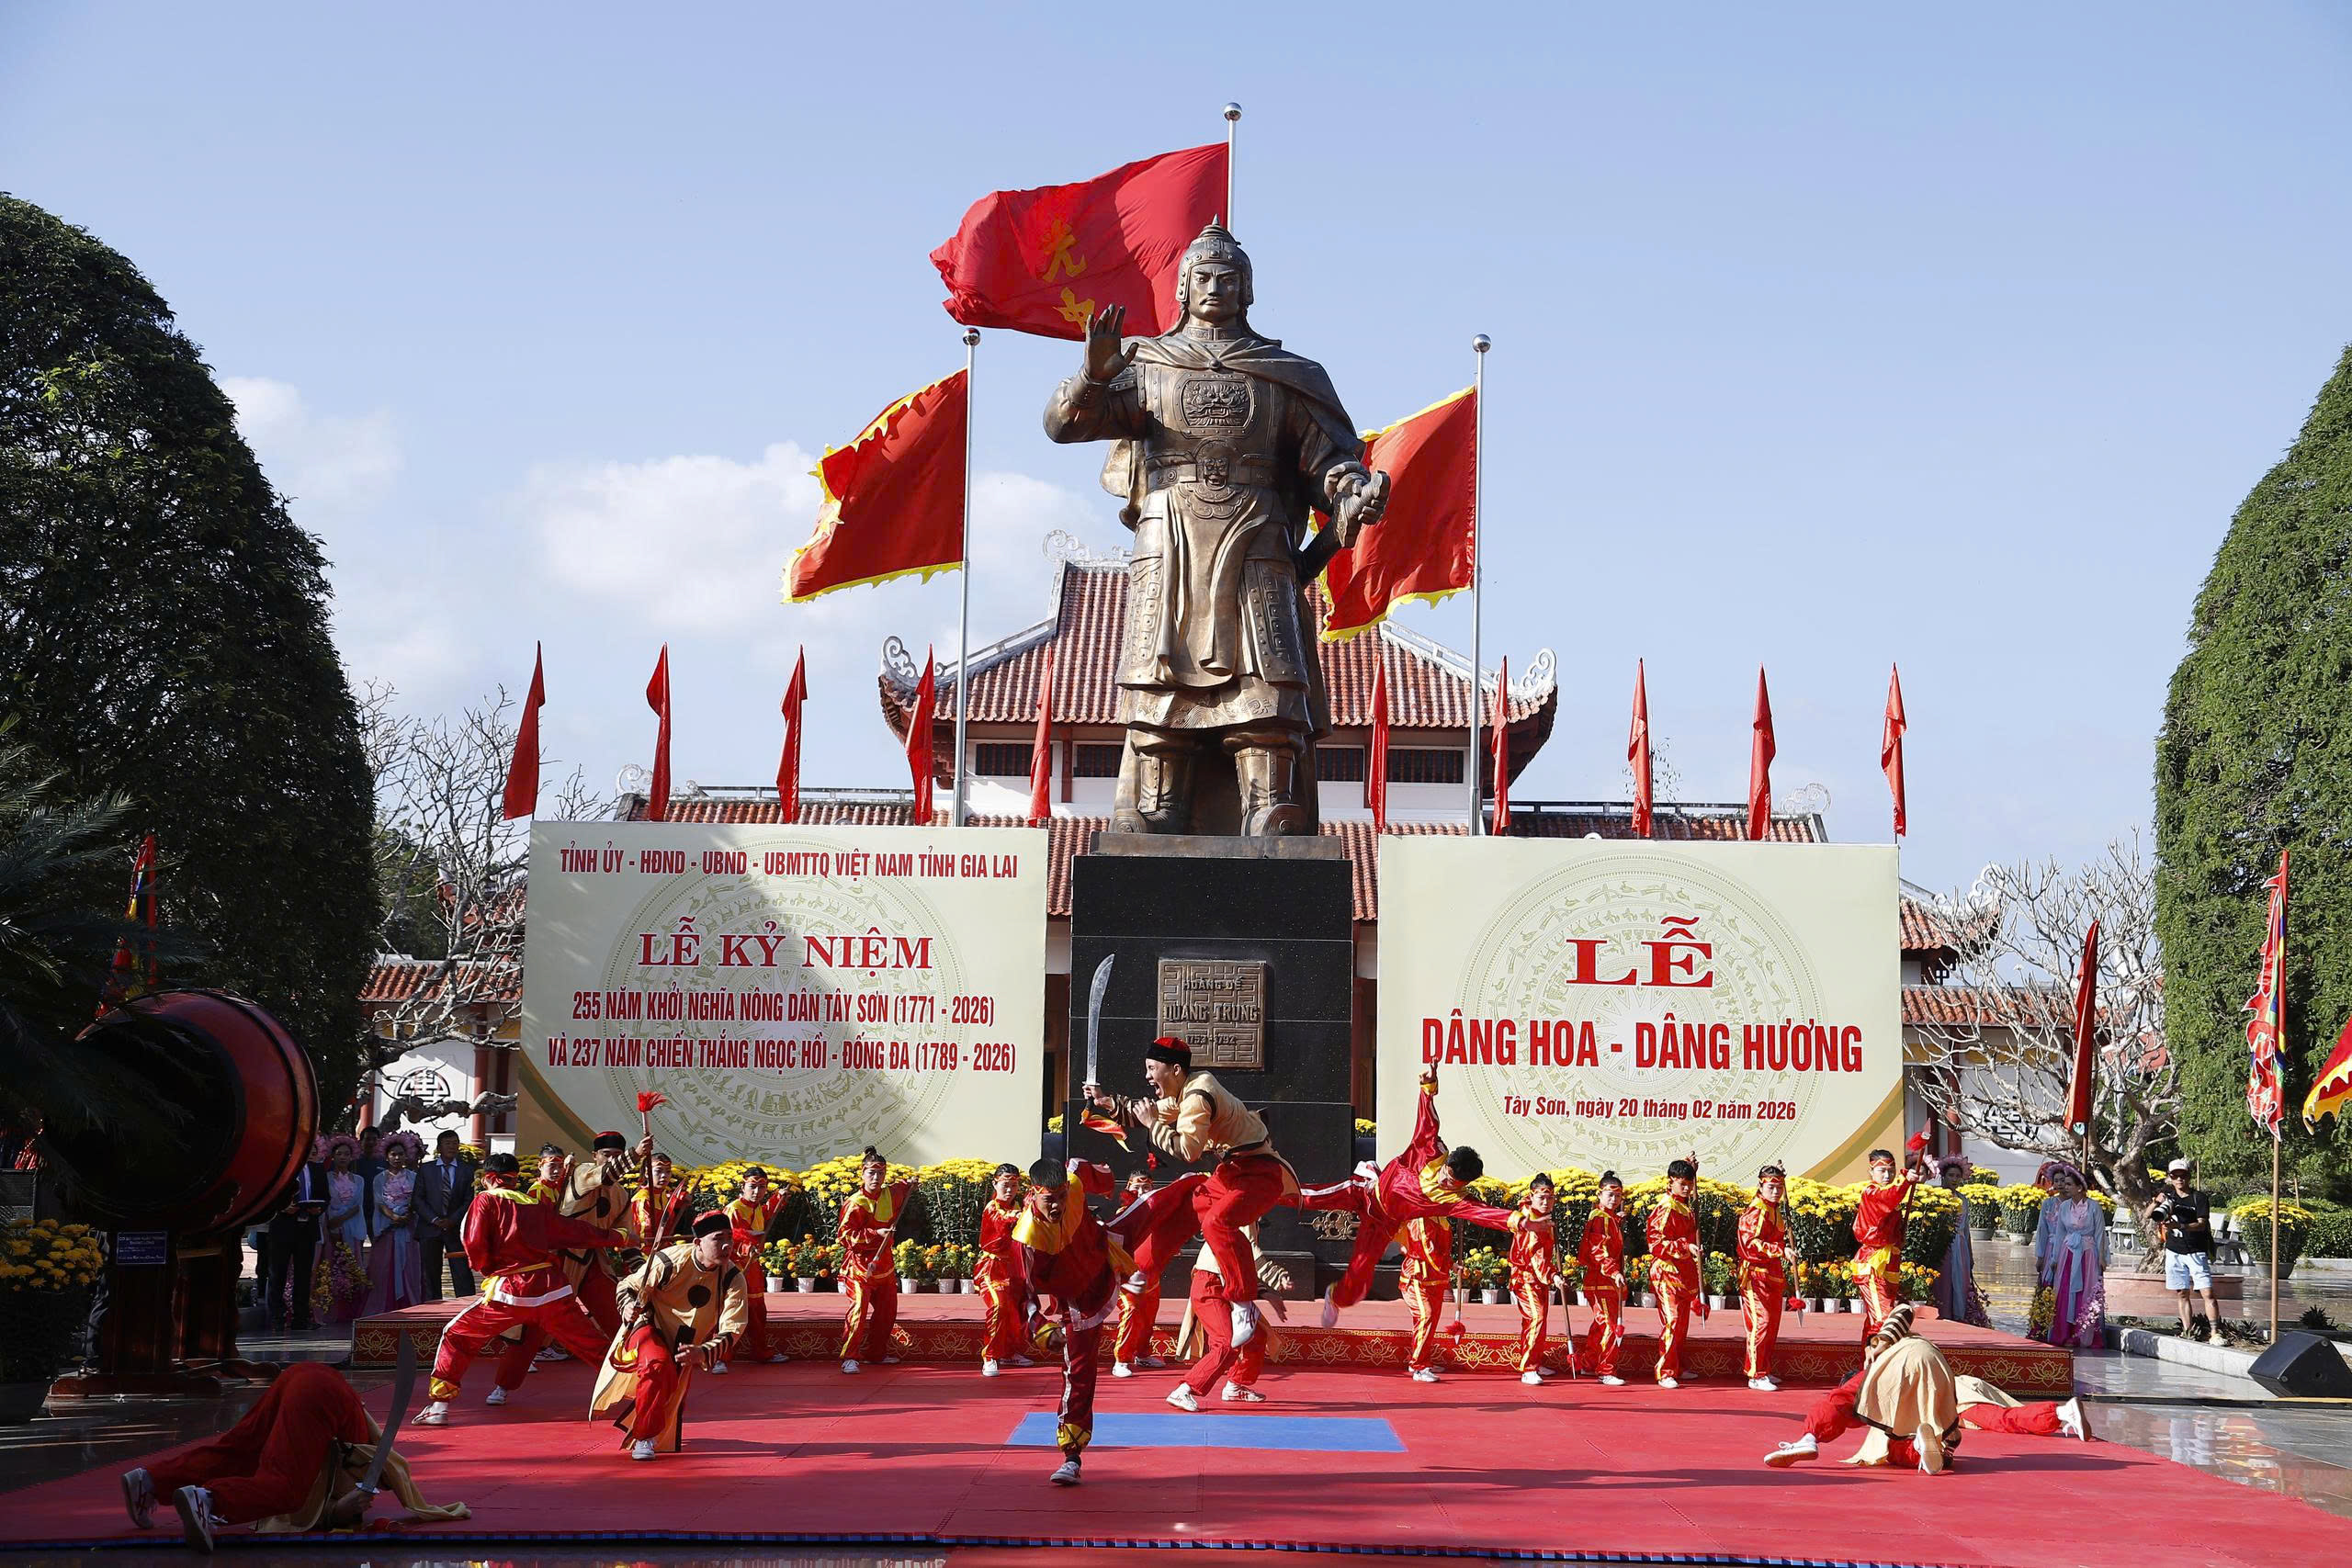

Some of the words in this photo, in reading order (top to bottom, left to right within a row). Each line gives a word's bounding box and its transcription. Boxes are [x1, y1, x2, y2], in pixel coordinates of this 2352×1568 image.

[560, 840, 597, 873] TỈNH
[603, 840, 624, 873] ỦY
[640, 850, 685, 874] HĐND
[702, 851, 747, 874] UBND
[764, 852, 829, 878] UBMTTQ
[835, 848, 870, 881] VIỆT
[876, 853, 913, 877] NAM
[919, 845, 956, 878] TỈNH
[961, 854, 988, 878] GIA
[993, 855, 1017, 878] LAI
[639, 916, 700, 966] LỄ
[718, 920, 786, 967] KỶ
[802, 926, 933, 977] NIỆM
[1565, 915, 1713, 988] LỄ
[572, 991, 601, 1020] 255
[605, 987, 641, 1021] NĂM
[647, 981, 683, 1021] KHỞI
[688, 987, 734, 1021] NGHĨA
[740, 987, 783, 1021] NÔNG
[788, 987, 820, 1022] DÂN
[824, 987, 853, 1022] TÂY
[856, 990, 888, 1023] SƠN
[894, 994, 934, 1026] (1771
[952, 996, 994, 1027] 2026)
[1164, 1004, 1209, 1021] QUANG
[1213, 1002, 1259, 1021] TRUNG
[548, 1032, 568, 1066] VÀ
[571, 1038, 601, 1066] 237
[605, 1032, 640, 1067] NĂM
[646, 1029, 693, 1068] CHIẾN
[698, 1028, 749, 1068] THẮNG
[754, 1039, 796, 1075] NGỌC
[802, 1032, 827, 1069] HỒI
[842, 1032, 885, 1070] ĐỐNG
[889, 1042, 910, 1070] ĐA
[915, 1042, 957, 1073] (1789
[973, 1043, 1016, 1074] 2026)
[1421, 1008, 1517, 1066] DÂNG
[1529, 1020, 1600, 1067] HOA
[1635, 1011, 1731, 1070] DÂNG
[1743, 1018, 1863, 1074] HƯƠNG
[1504, 1096, 1531, 1117] Tây
[1536, 1096, 1570, 1118] Sơn,
[1576, 1097, 1614, 1119] ngày
[1618, 1099, 1638, 1118] 20
[1643, 1099, 1688, 1120] tháng
[1692, 1100, 1713, 1118] 02
[1717, 1100, 1751, 1119] năm
[1757, 1101, 1796, 1120] 2026
